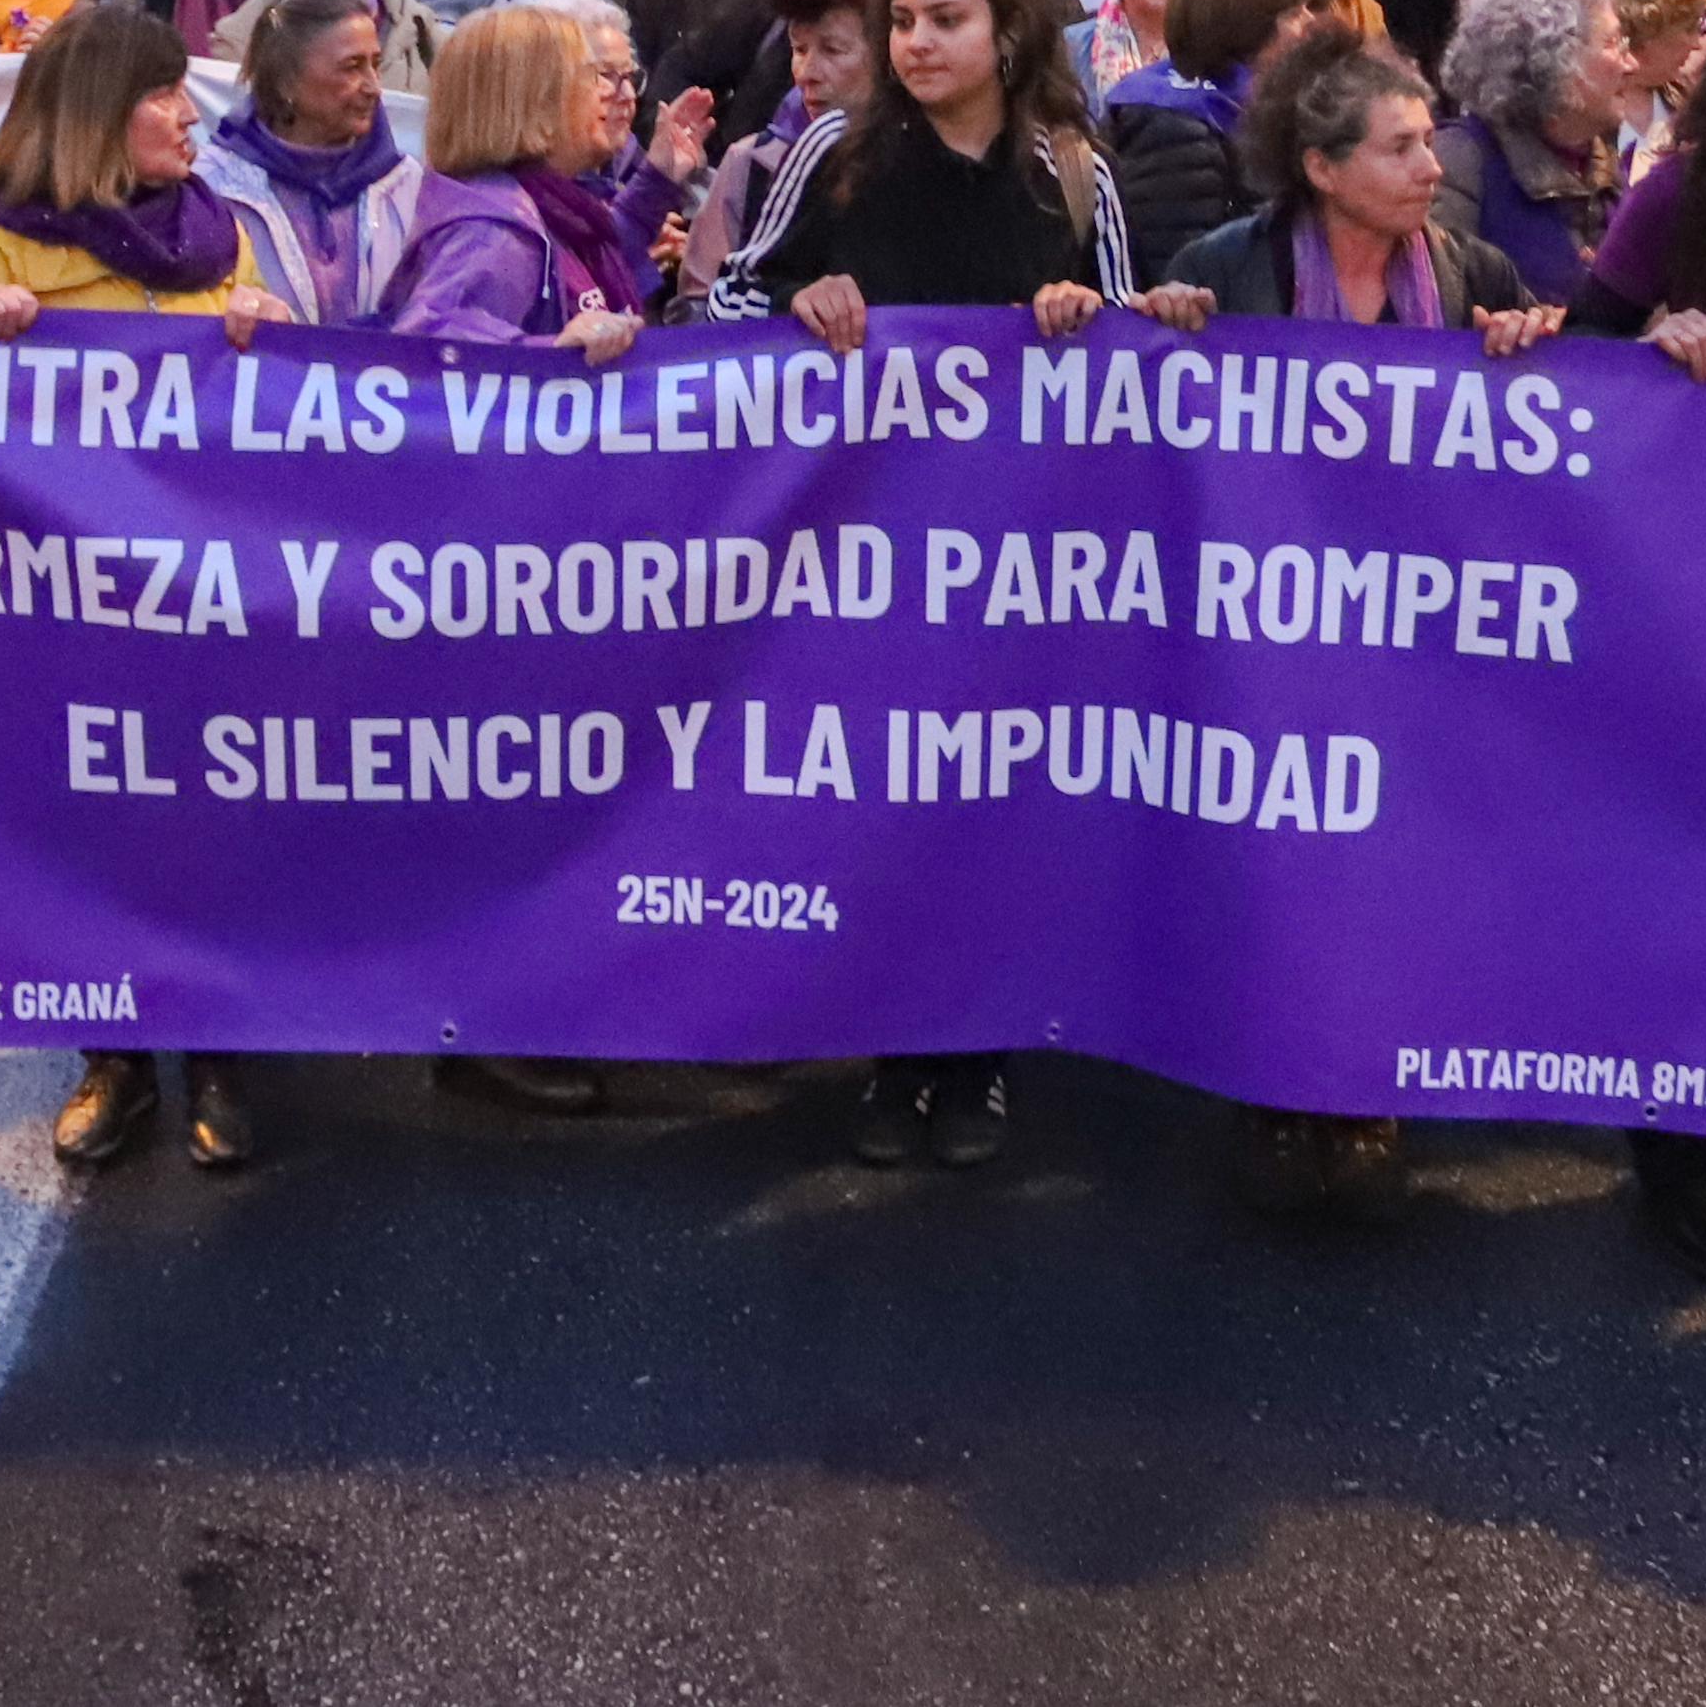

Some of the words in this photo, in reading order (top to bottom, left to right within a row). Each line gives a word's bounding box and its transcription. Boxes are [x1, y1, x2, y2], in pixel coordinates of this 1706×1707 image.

[231, 355, 409, 454] LAS
[443, 346, 989, 455] VIOLENCIAS
[1021, 347, 1594, 477] MACHISTAS:
[280, 541, 340, 637] Y
[370, 525, 893, 639] SORORIDAD
[926, 528, 1167, 627] PARA
[1197, 541, 1578, 663] ROMPER
[68, 704, 176, 795] EL
[204, 712, 624, 800] SILENCIO
[656, 701, 711, 790] Y
[744, 700, 856, 800] LA
[887, 705, 1380, 832] IMPUNIDAD
[617, 874, 839, 931] 25N-2024
[13, 973, 138, 1021] GRANÁ
[1396, 1048, 1641, 1099] PLATAFORMA
